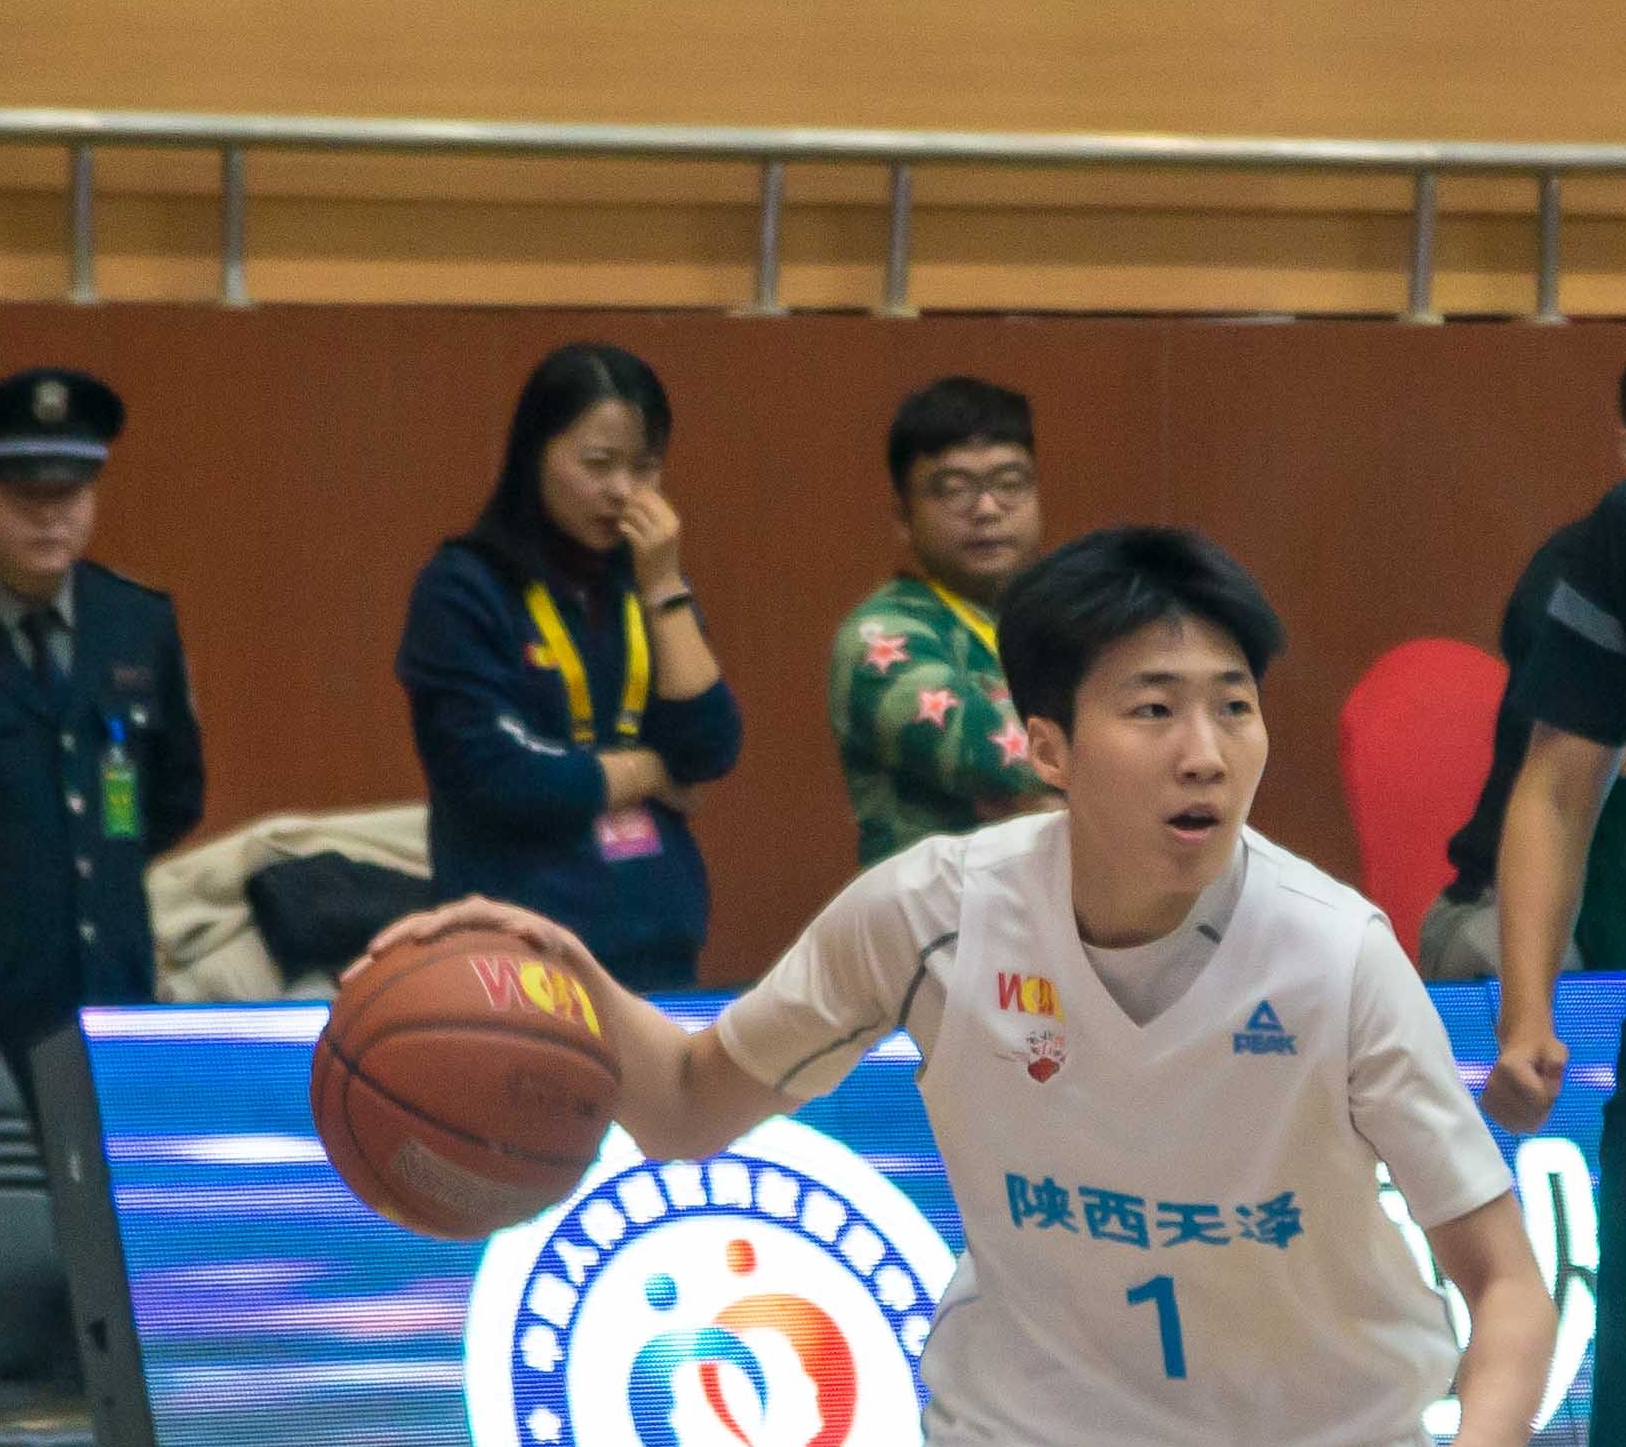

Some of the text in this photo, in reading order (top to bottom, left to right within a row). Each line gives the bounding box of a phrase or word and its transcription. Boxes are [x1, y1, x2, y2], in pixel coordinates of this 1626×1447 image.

[1232, 1033, 1298, 1055] PEAK
[1004, 1170, 1305, 1249] 陕西天泽
[1126, 1275, 1186, 1380] 1
